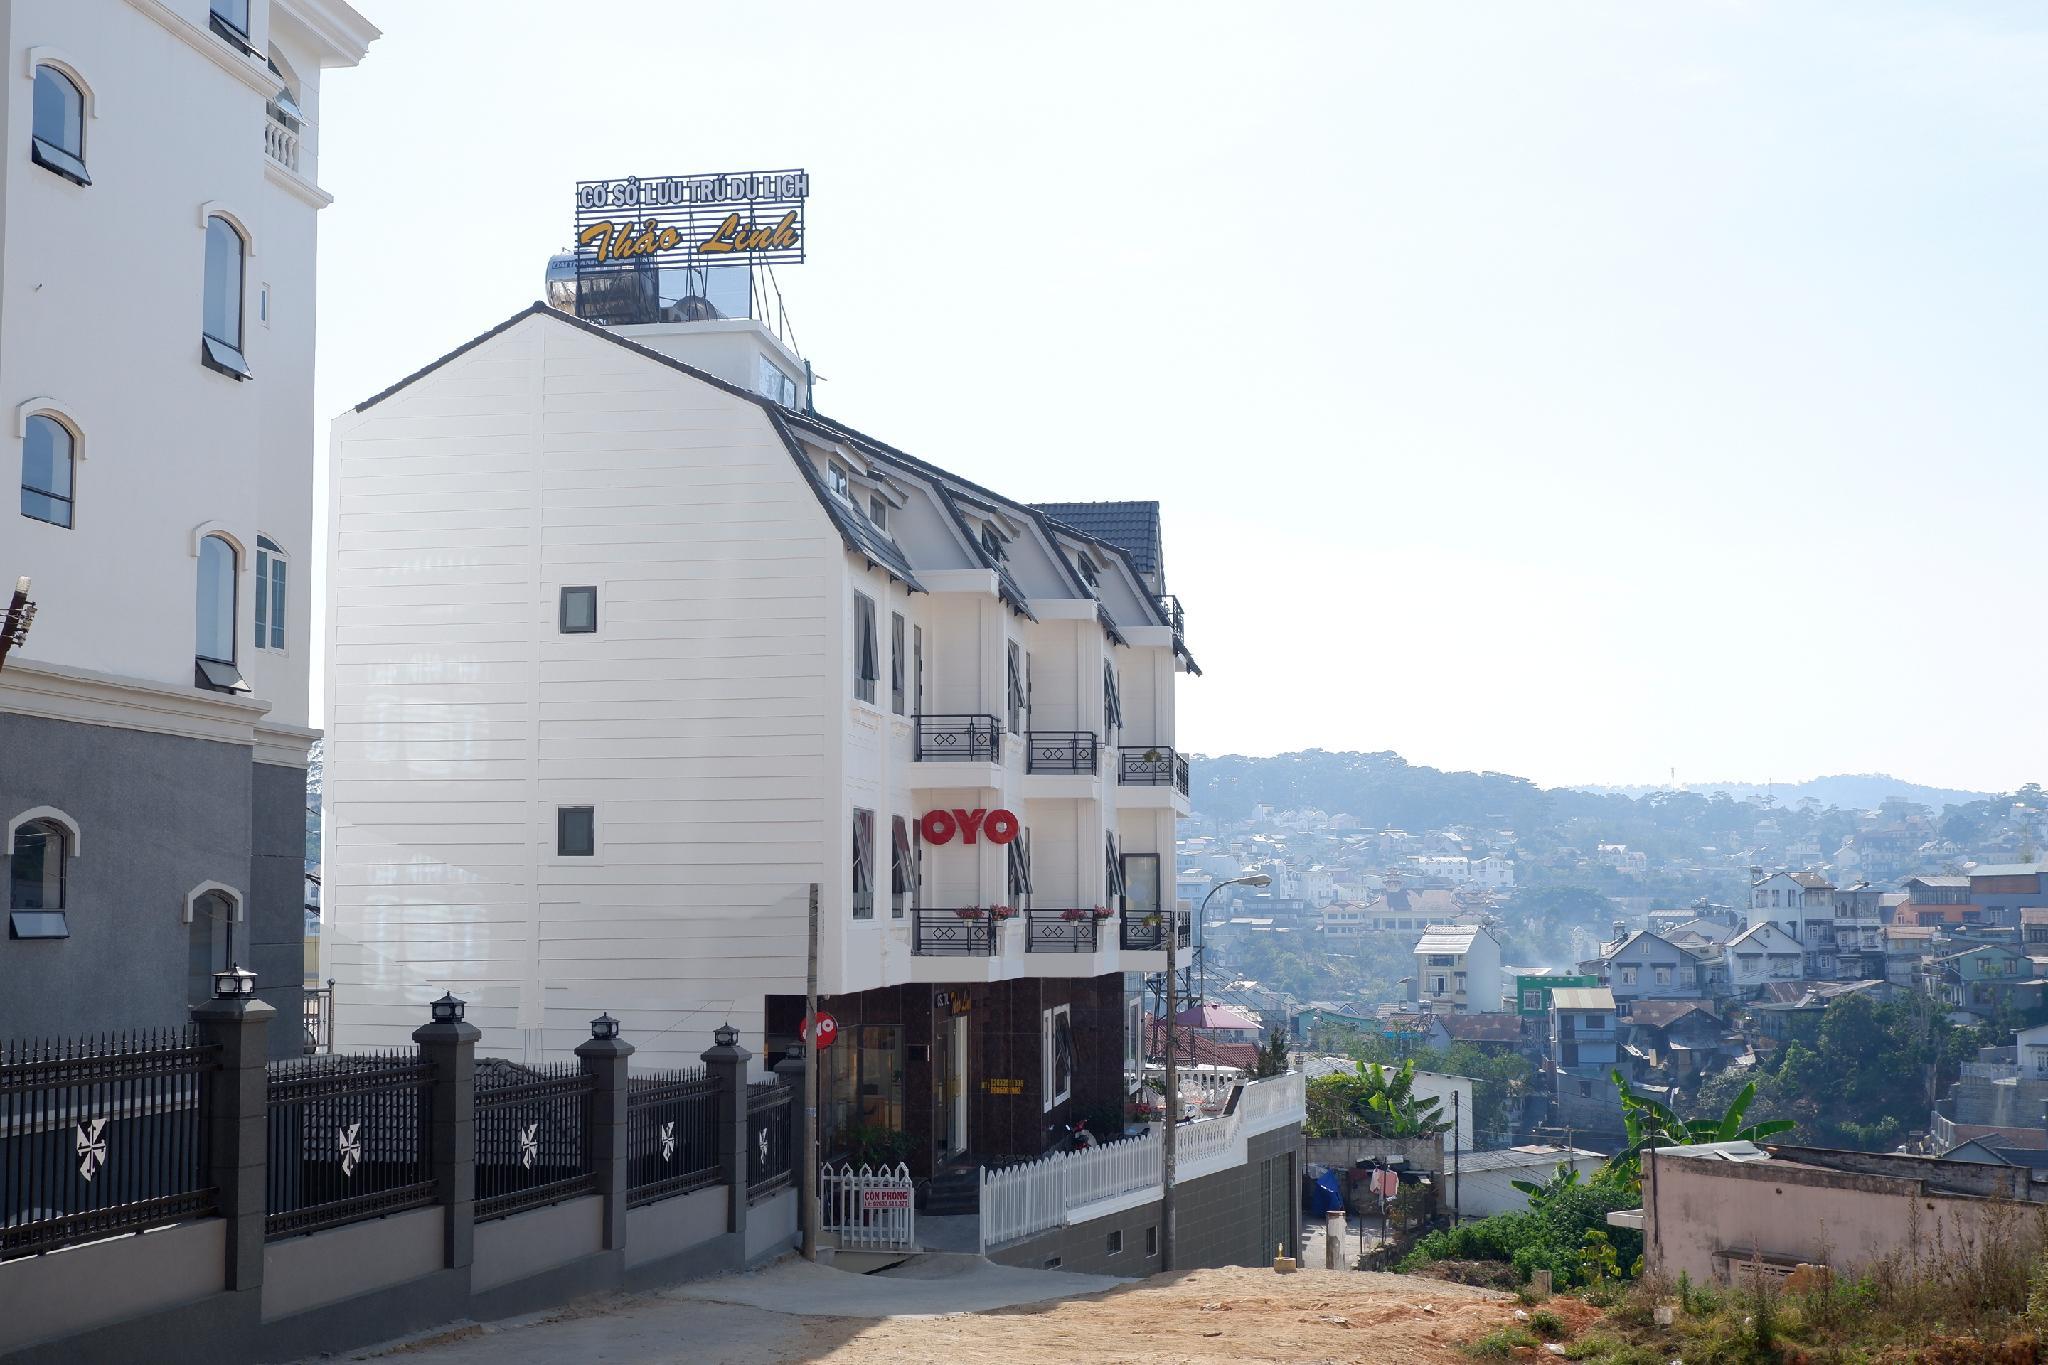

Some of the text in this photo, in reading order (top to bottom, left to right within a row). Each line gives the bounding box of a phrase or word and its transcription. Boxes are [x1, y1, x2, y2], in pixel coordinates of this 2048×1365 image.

[580, 173, 809, 209] CƠ SỞ LƯU TRÚ DU LỊCH
[580, 210, 799, 262] Thảo Linh
[921, 808, 1019, 845] OYO
